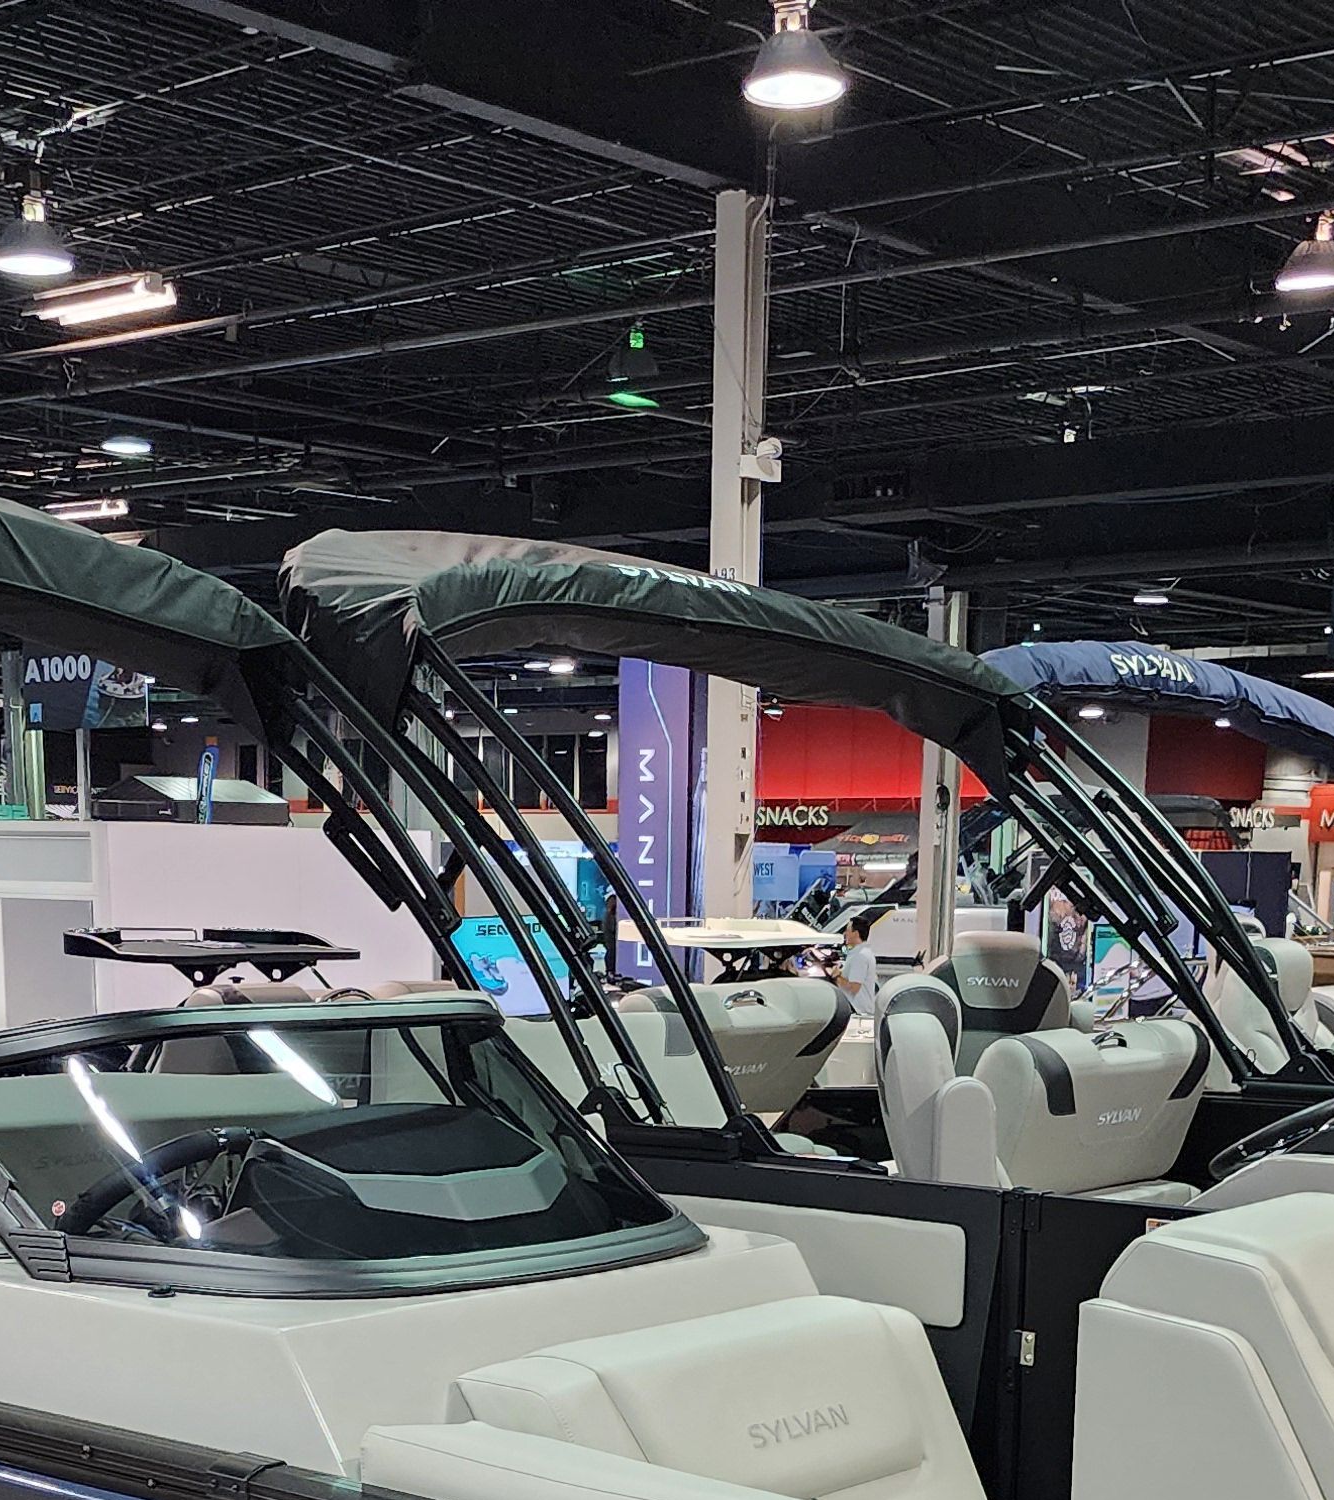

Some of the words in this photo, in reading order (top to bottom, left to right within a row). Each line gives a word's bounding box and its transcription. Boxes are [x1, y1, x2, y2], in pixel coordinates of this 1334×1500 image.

[608, 563, 752, 596] SYLVAN
[24, 654, 91, 684] A1000
[1110, 654, 1195, 683] SYLVAN
[756, 805, 829, 826] SNACKS
[1230, 806, 1276, 828] SNACKS
[966, 976, 1019, 988] SYLVAN
[1097, 1106, 1143, 1126] SYLVAN
[747, 1402, 850, 1450] SYLVAN
